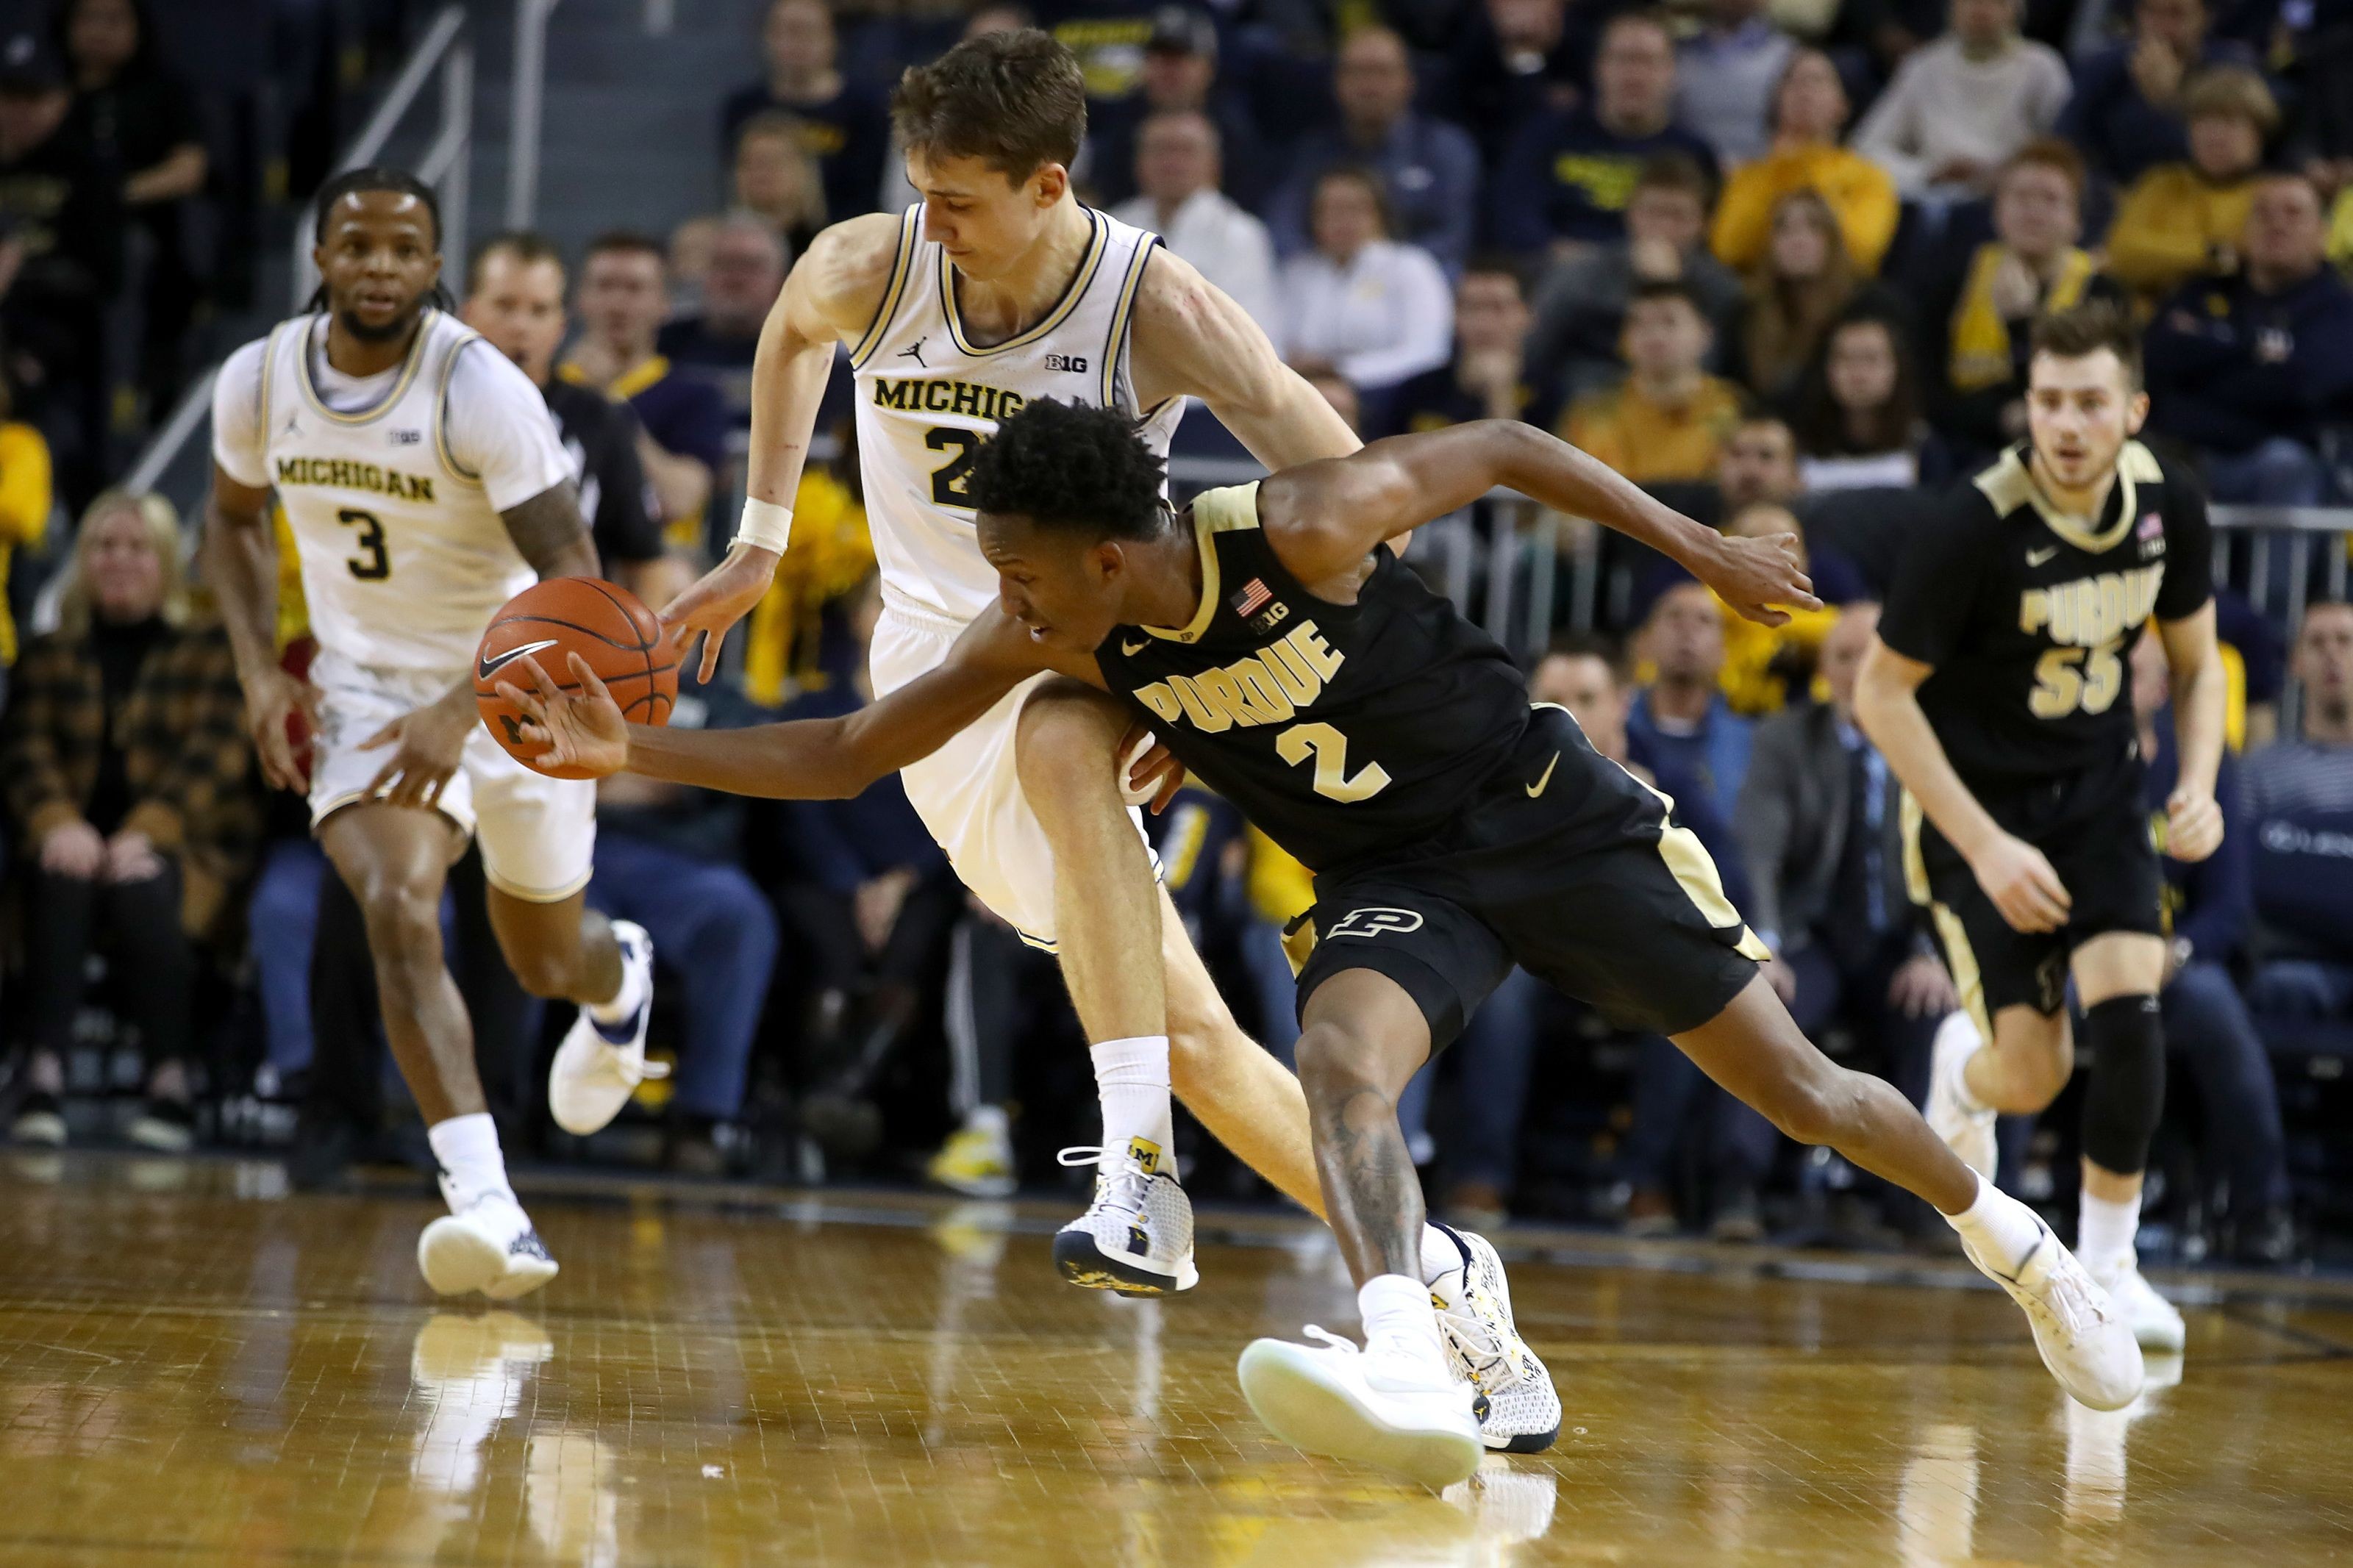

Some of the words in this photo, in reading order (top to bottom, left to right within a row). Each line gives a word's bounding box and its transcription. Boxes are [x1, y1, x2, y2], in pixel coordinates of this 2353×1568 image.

[874, 379, 1024, 419] MICHIG
[277, 457, 435, 503] MICHIGAN
[926, 427, 981, 509] 2
[338, 509, 390, 579] 3
[2019, 561, 2166, 647] PURDU
[1132, 619, 1346, 733] PURDUE
[2028, 638, 2123, 719] 55
[1276, 721, 1392, 803] 2
[1326, 907, 1424, 940] P
[1134, 1148, 1154, 1167] M
